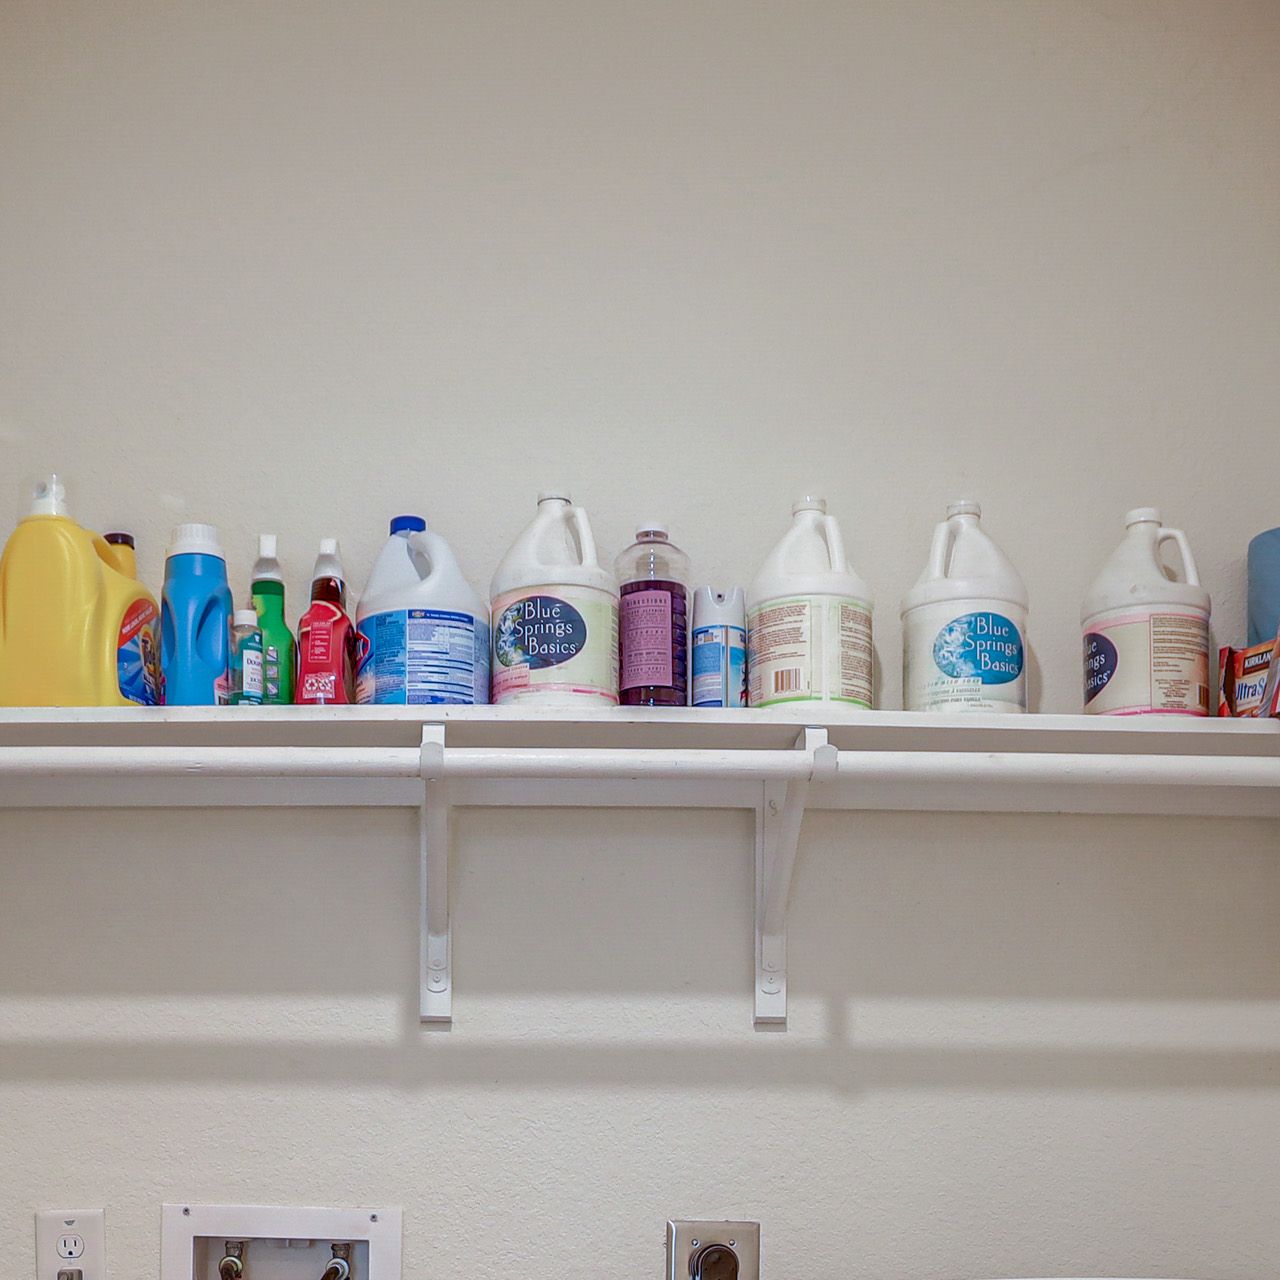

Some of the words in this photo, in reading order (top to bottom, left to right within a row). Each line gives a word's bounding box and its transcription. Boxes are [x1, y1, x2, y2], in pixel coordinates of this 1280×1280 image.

[525, 598, 561, 619] Blue
[515, 619, 573, 645] Springs
[977, 615, 1009, 637] Blue
[529, 637, 576, 655] Basics
[965, 632, 1017, 660] Springs
[981, 653, 1019, 674] Basics
[1244, 650, 1272, 669] KIRKLAN
